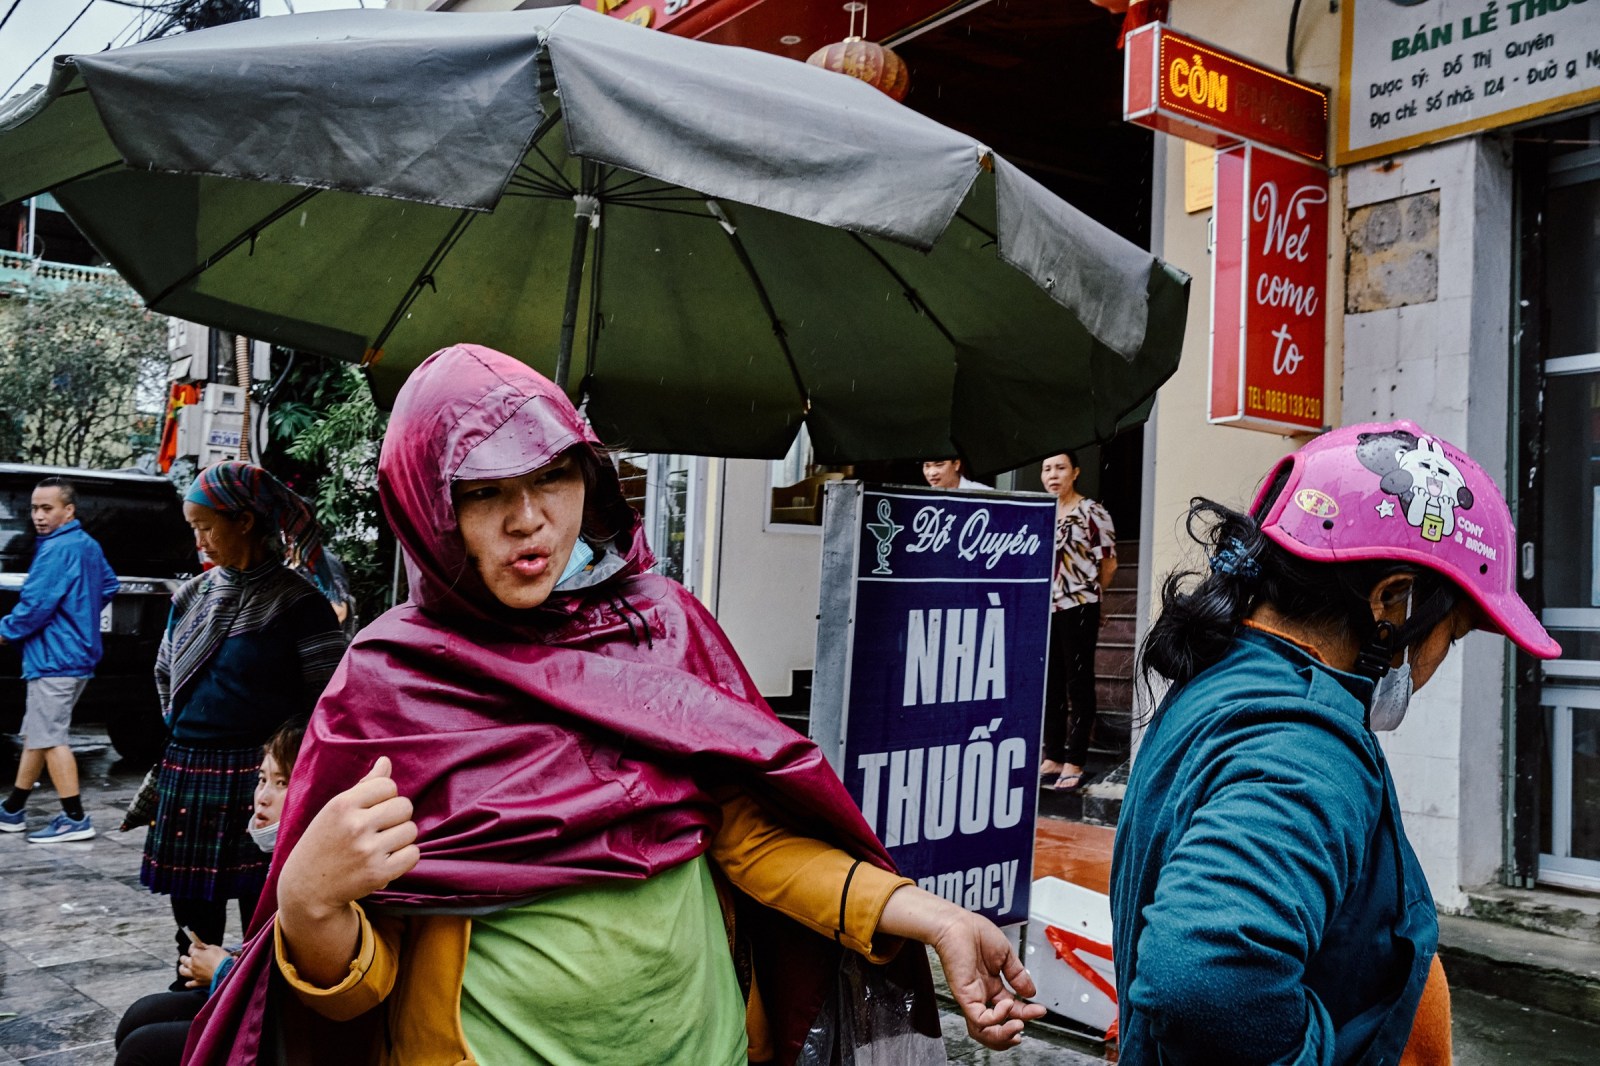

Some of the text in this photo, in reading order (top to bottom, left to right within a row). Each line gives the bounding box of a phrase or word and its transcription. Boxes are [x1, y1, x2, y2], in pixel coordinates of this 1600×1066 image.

[1391, 0, 1588, 61] BÁN LẺ THU
[1169, 54, 1229, 113] CÒN
[1370, 78, 1403, 99] Dược
[1473, 49, 1492, 69] Thị
[1426, 91, 1443, 113] Số
[1484, 76, 1505, 97] 124
[1252, 181, 1328, 263] Wel
[1256, 272, 1319, 317] come
[1271, 323, 1304, 376] to
[905, 505, 1041, 570] Đỗ Quyên
[1457, 516, 1484, 538] CONY
[902, 592, 1006, 707] NHÀ
[857, 717, 1027, 849] THUỐC
